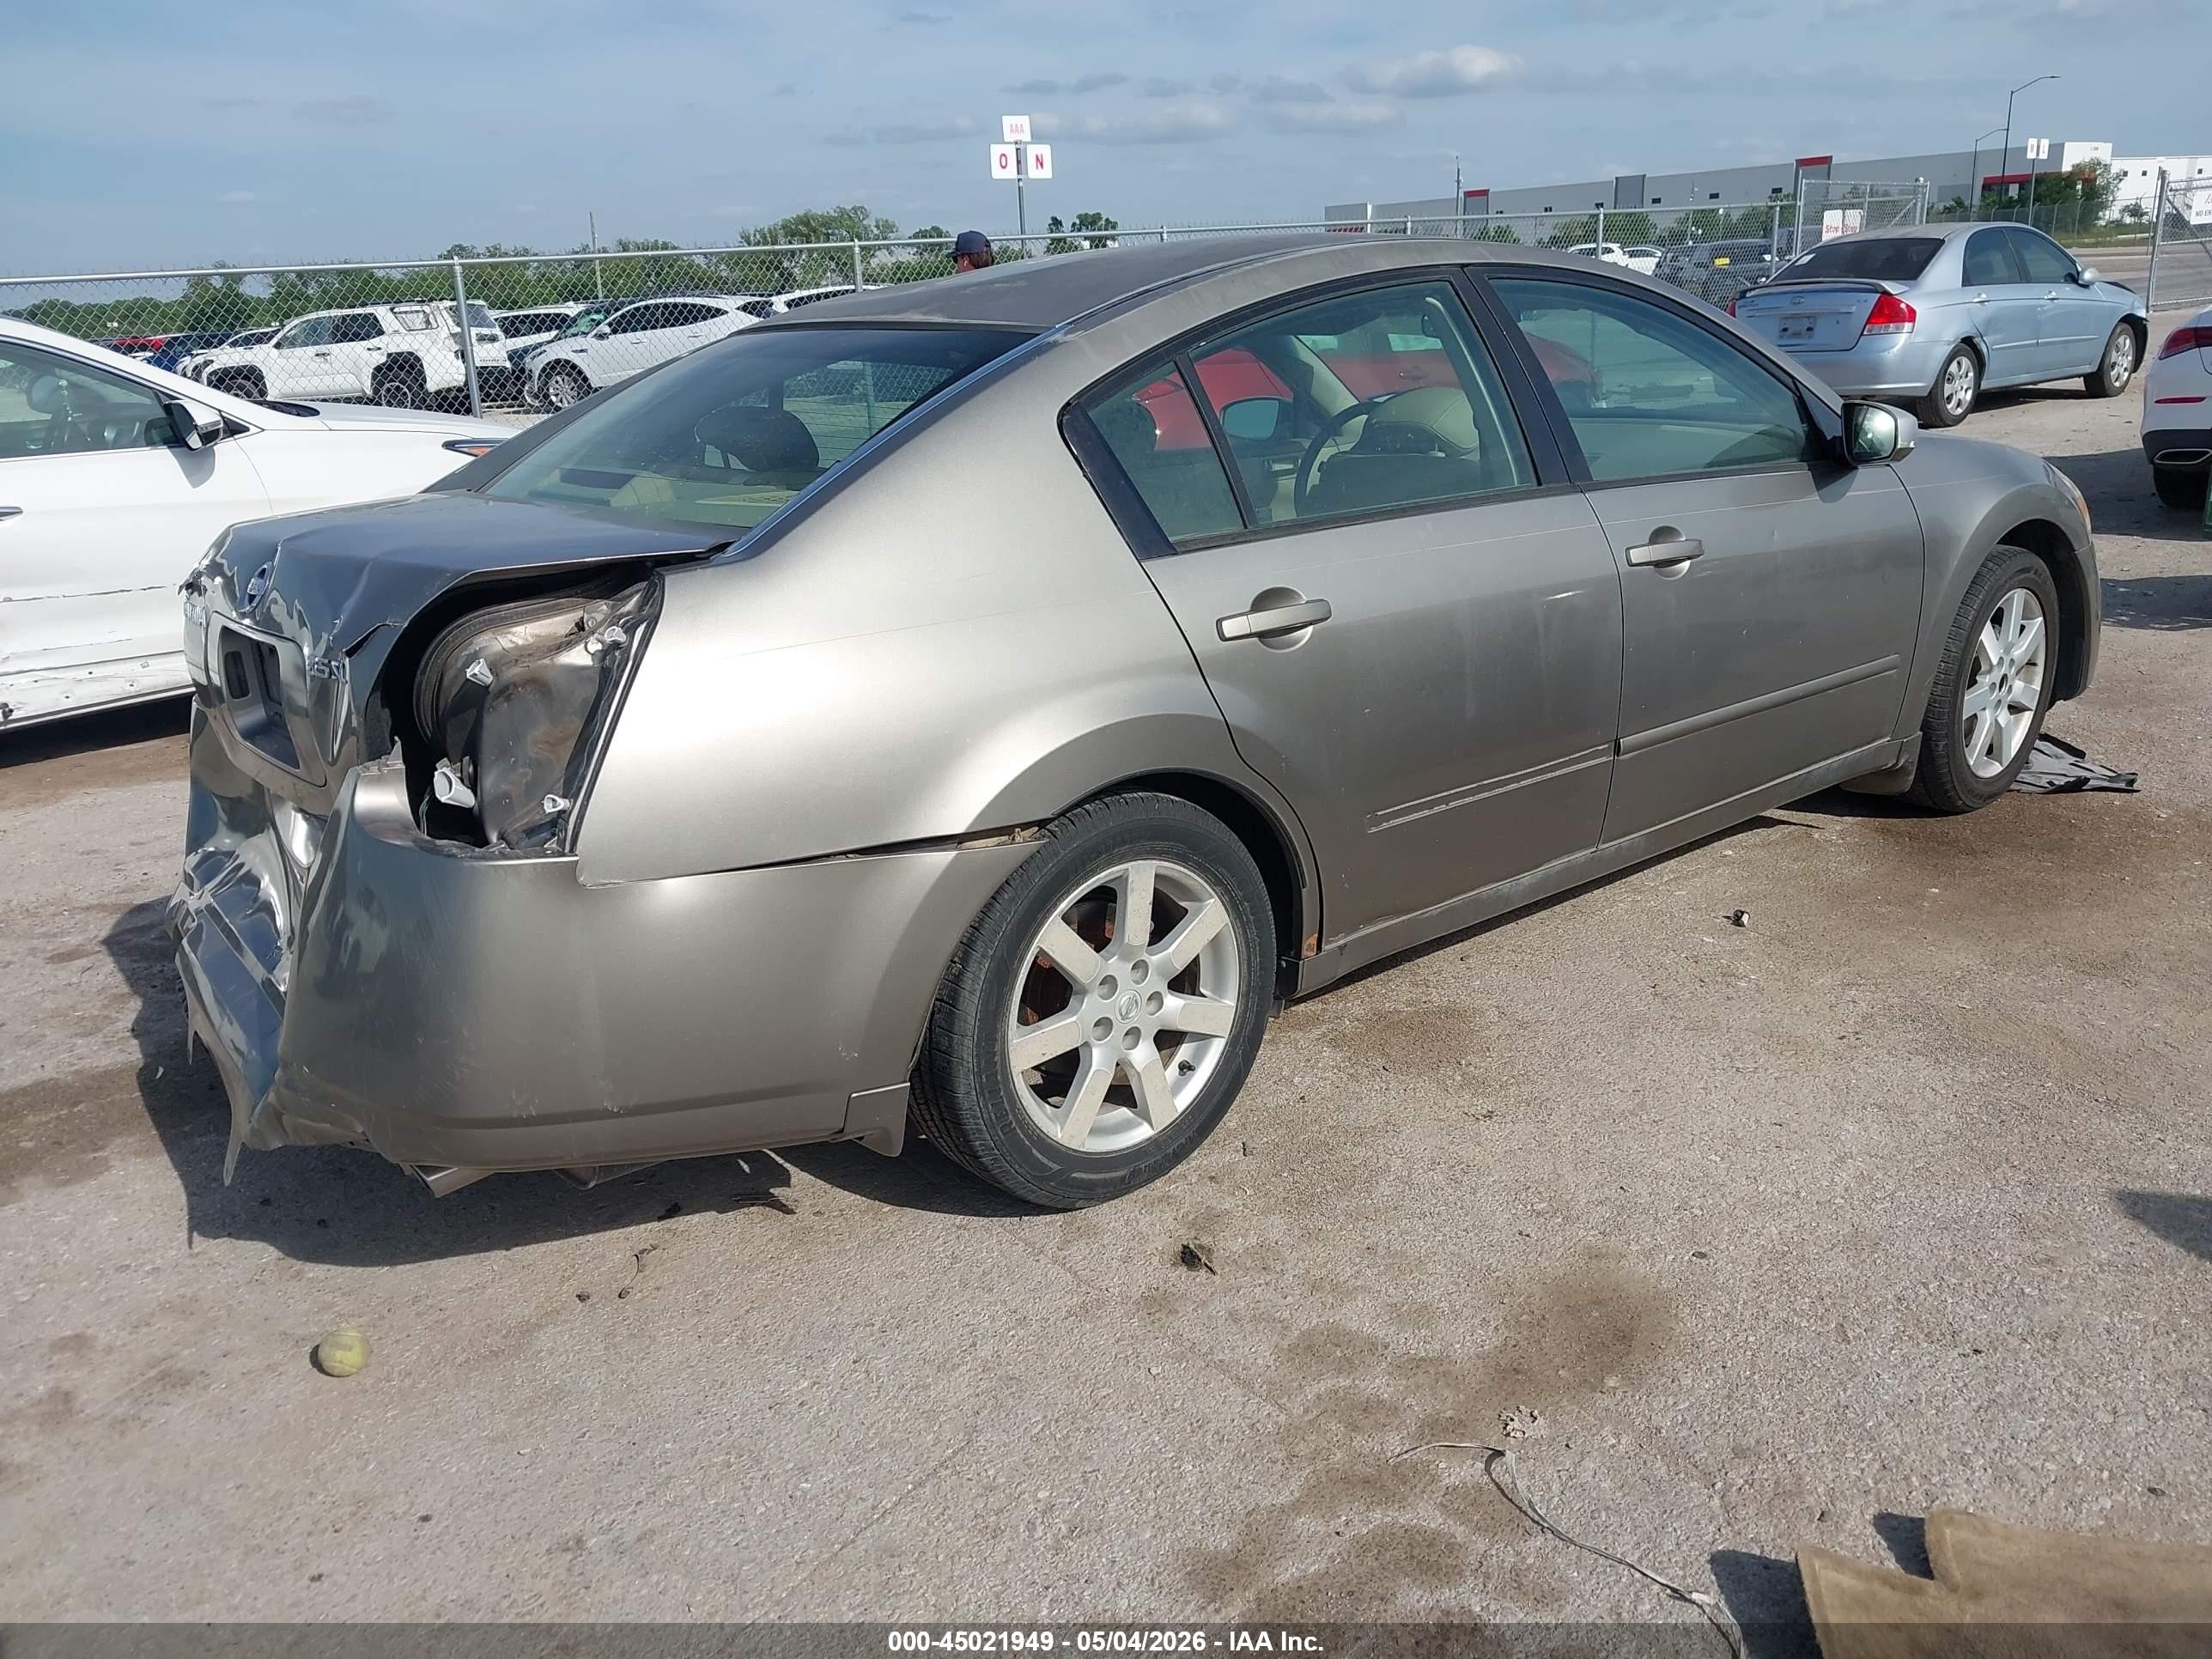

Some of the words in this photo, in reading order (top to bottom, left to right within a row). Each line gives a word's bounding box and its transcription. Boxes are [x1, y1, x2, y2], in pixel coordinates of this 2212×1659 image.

[1009, 123, 1024, 135] AAA
[999, 153, 1008, 170] O
[1035, 153, 1044, 171] N
